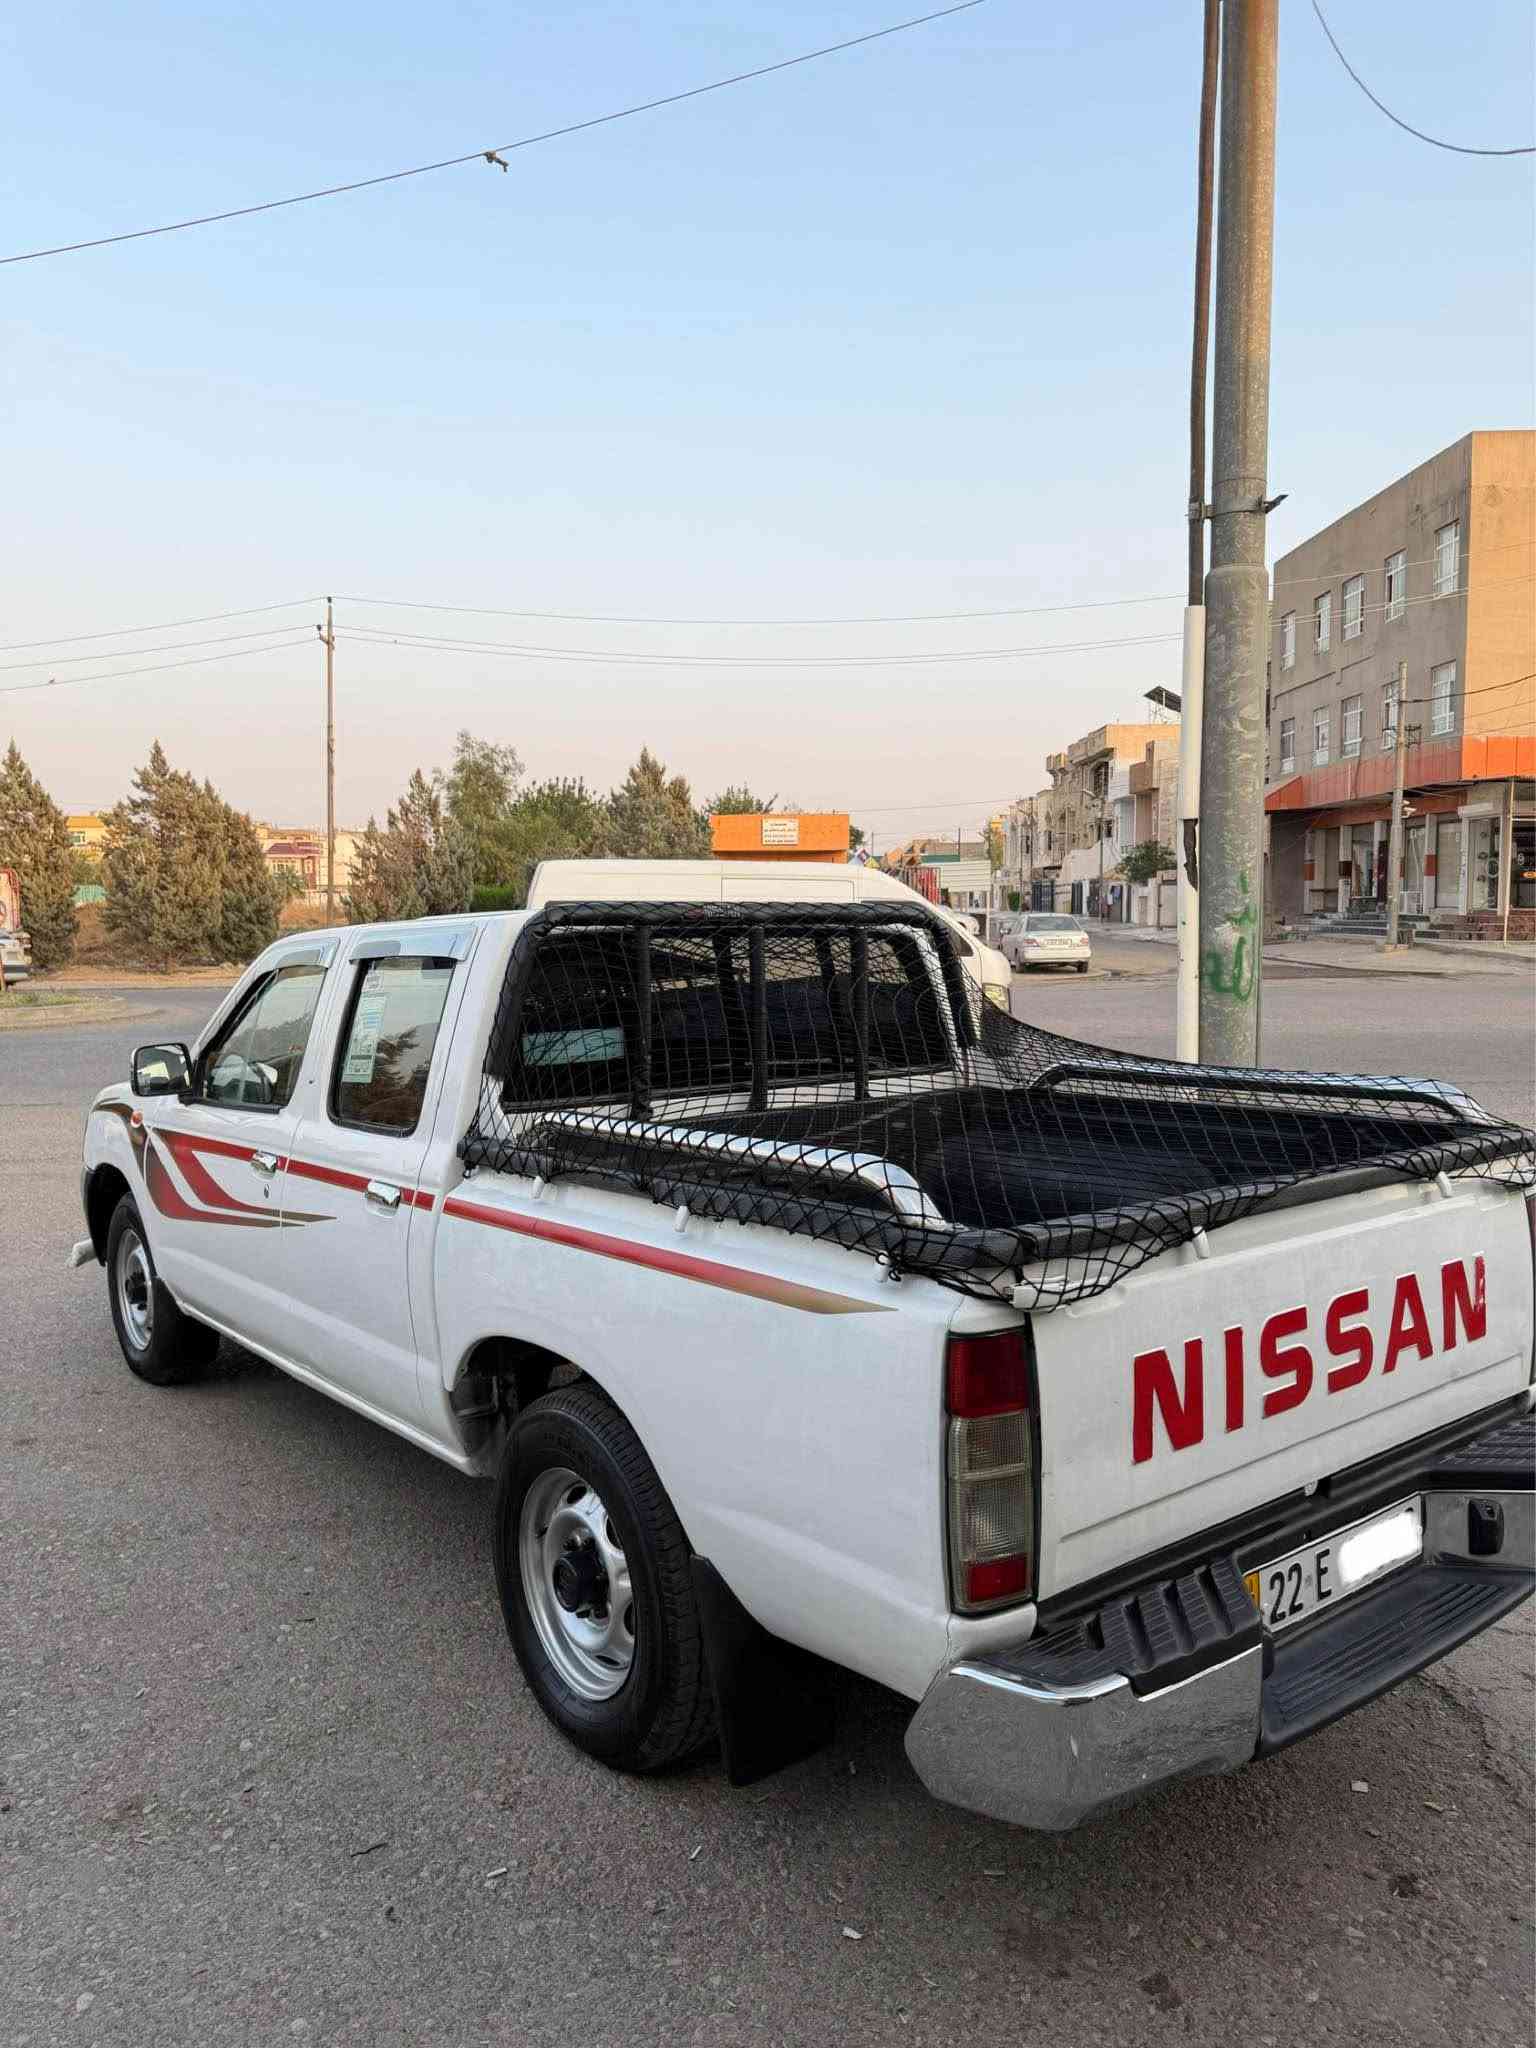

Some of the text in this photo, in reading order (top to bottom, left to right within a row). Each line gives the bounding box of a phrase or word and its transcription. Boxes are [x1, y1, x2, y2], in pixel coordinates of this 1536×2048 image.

[1132, 1253, 1487, 1465] NISSAN
[1269, 1548, 1333, 1625] 22 E
